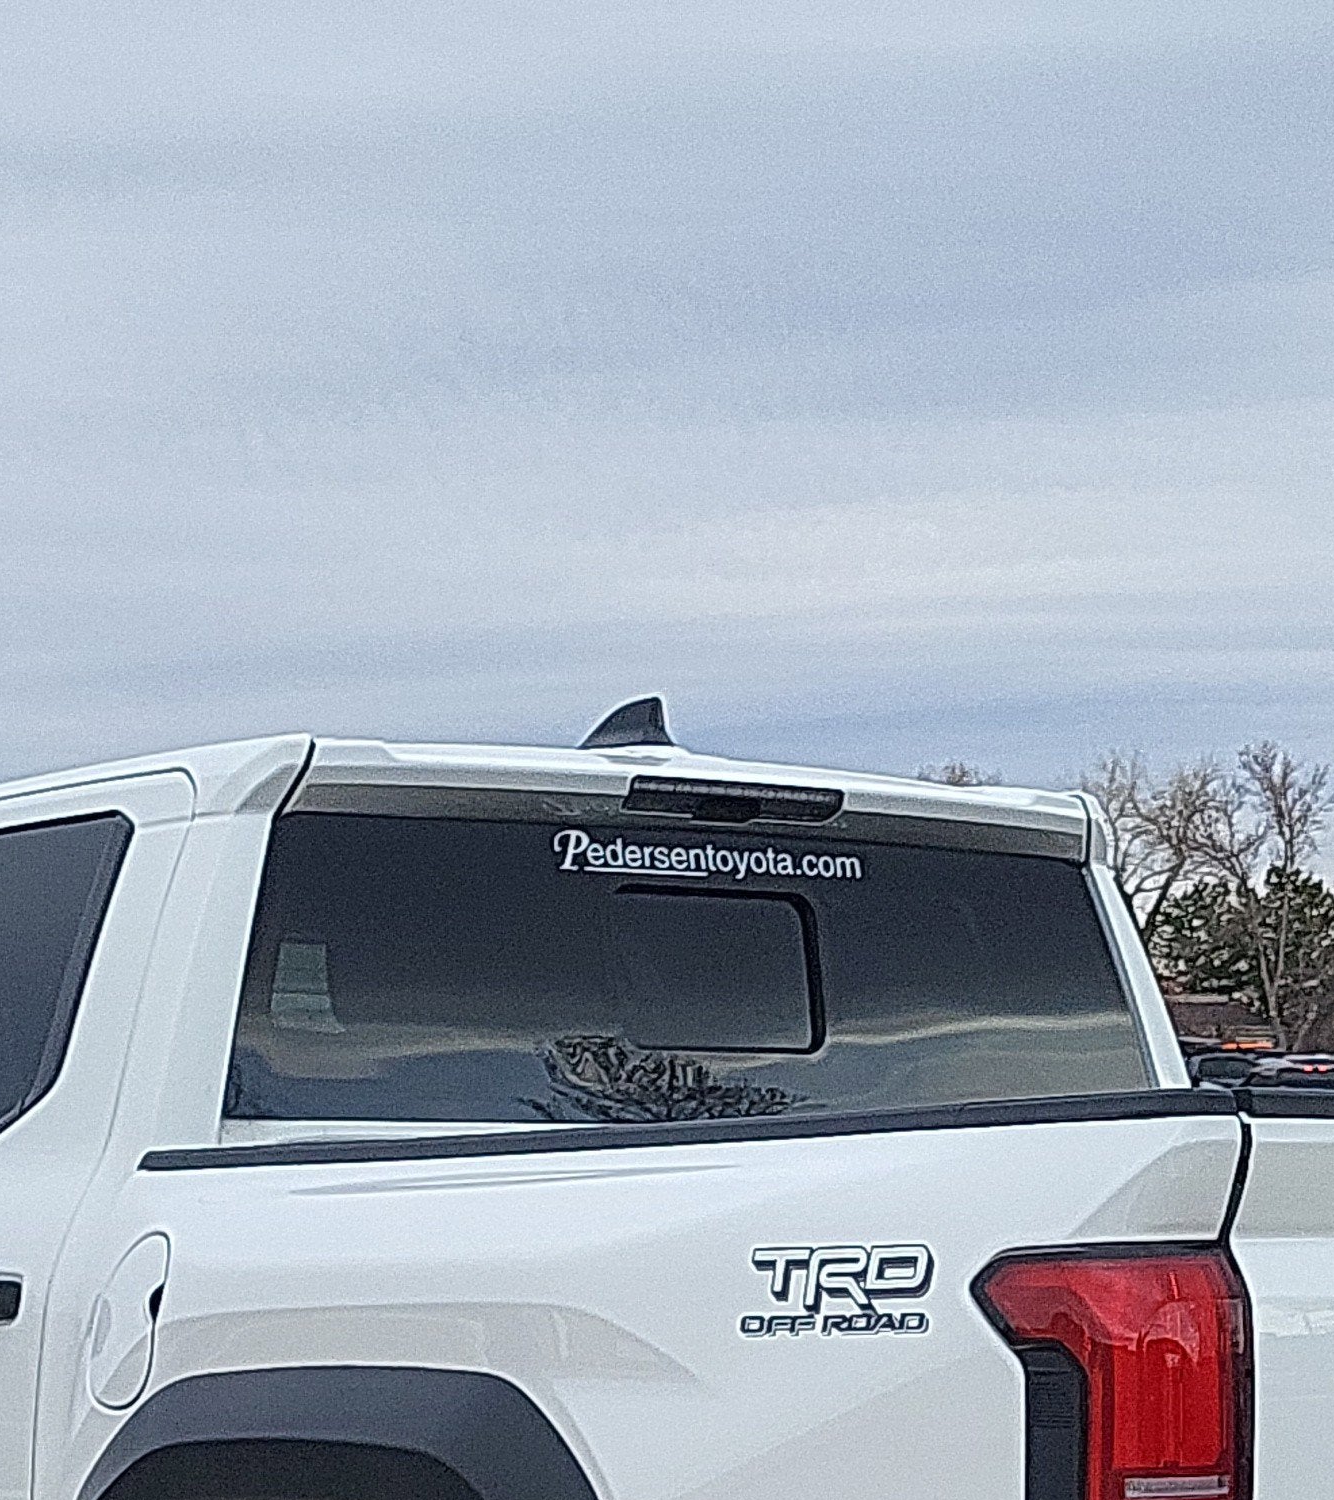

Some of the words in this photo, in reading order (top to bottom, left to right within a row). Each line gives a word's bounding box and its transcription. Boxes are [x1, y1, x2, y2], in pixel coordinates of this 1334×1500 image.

[553, 829, 862, 879] Pedersentoyota.com
[751, 1243, 935, 1314] TRD
[740, 1314, 816, 1337] OFF
[821, 1312, 930, 1337] ROAD
